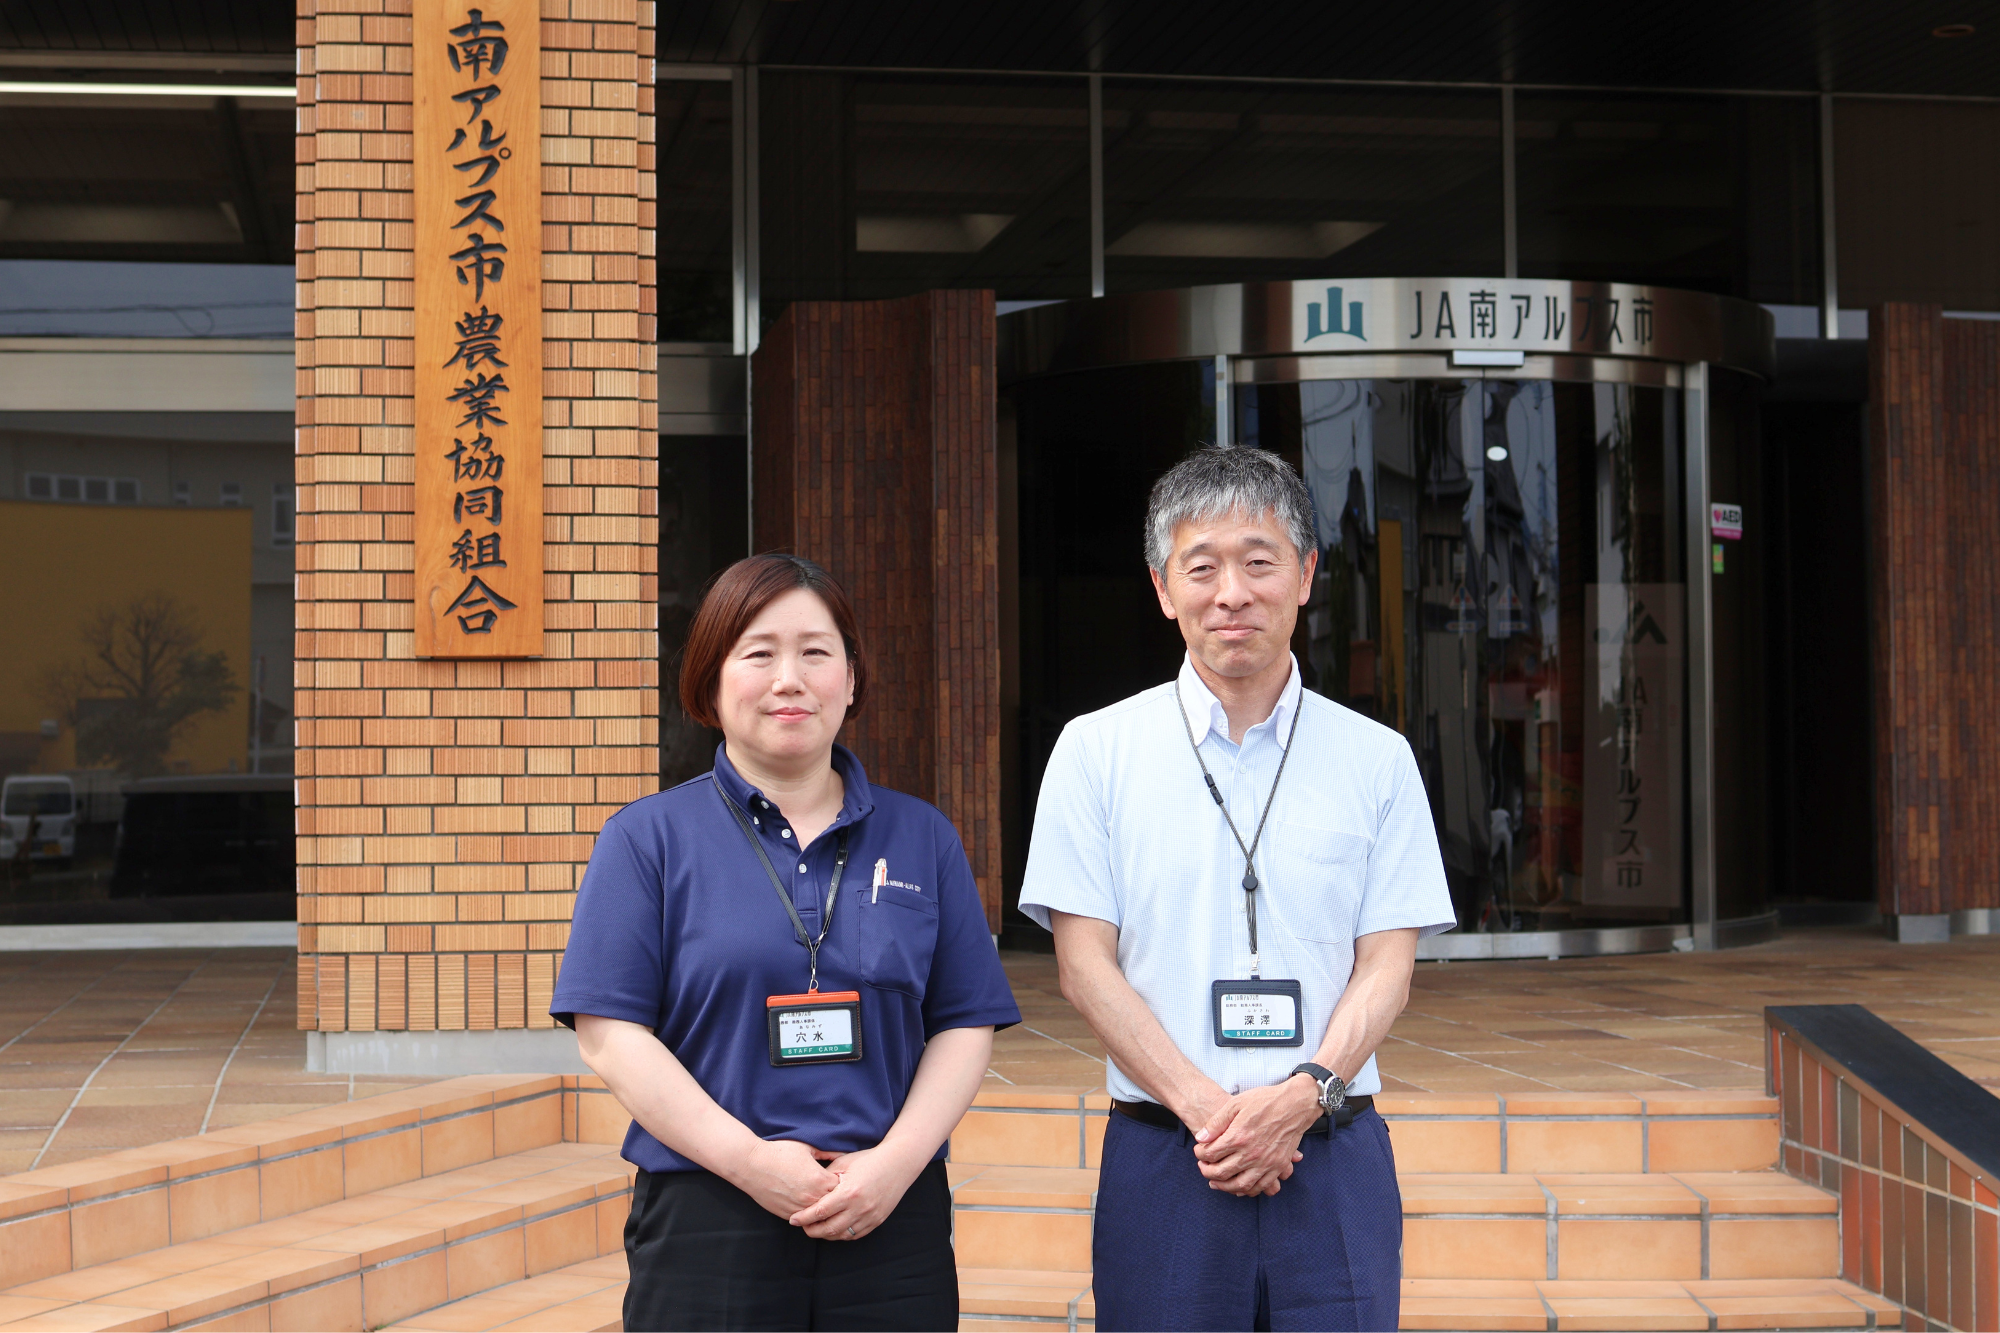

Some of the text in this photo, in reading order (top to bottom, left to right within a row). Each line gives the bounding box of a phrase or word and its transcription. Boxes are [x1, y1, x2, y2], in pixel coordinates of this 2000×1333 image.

[442, 8, 519, 636] 南アルプス市農業協同組合
[1410, 289, 1654, 346] JA南アルプス市
[1722, 509, 1741, 523] AED
